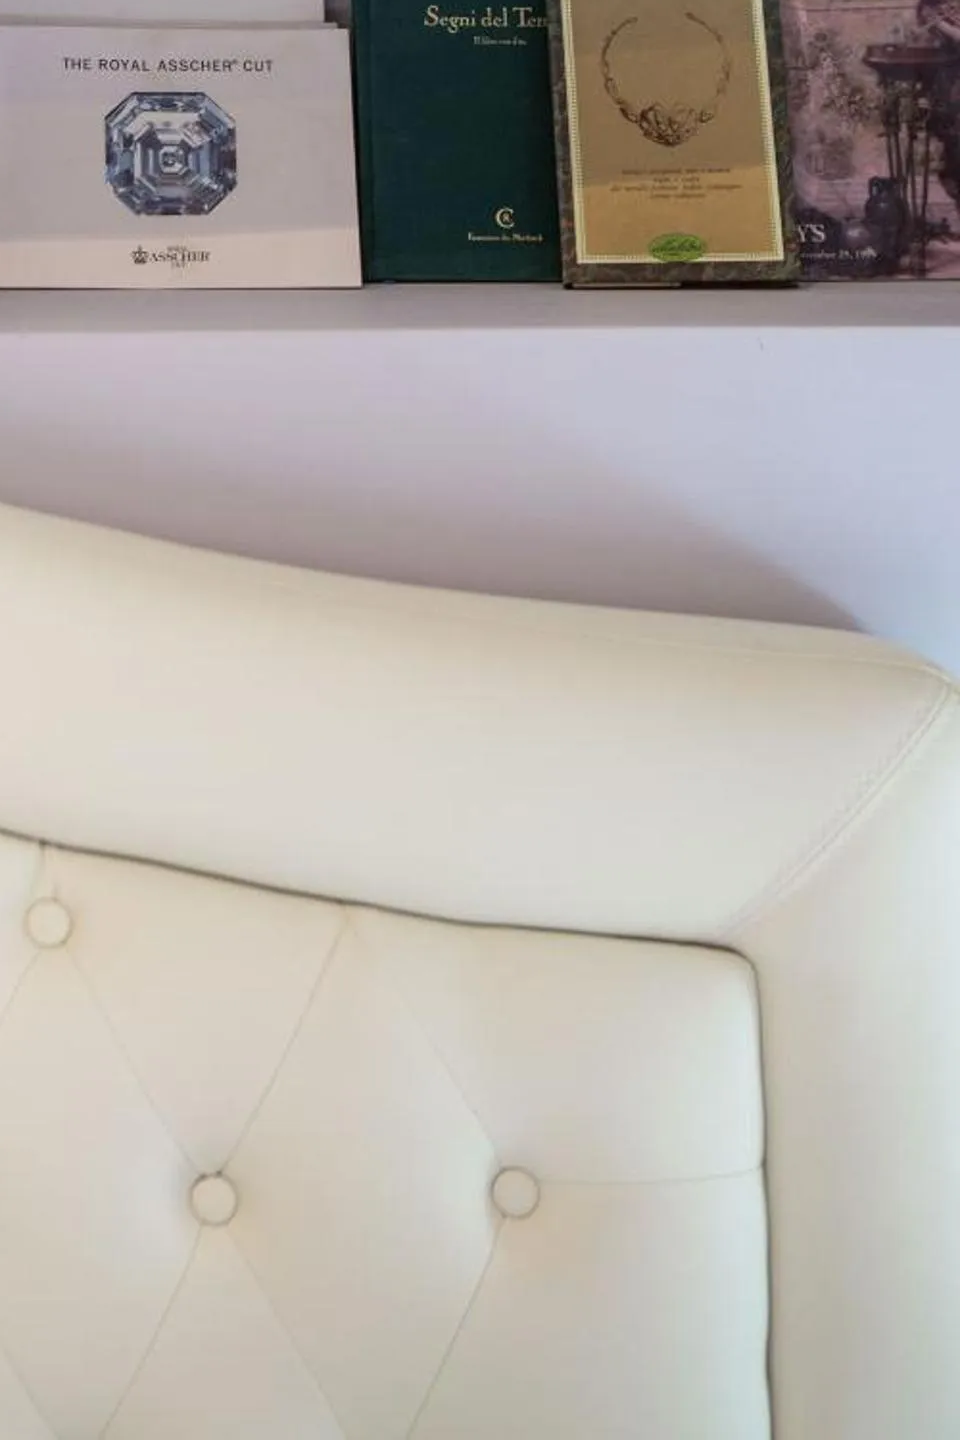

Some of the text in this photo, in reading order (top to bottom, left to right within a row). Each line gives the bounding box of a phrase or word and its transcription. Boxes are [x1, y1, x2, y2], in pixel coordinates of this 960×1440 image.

[424, 4, 477, 34] Segni
[481, 6, 508, 28] del
[64, 57, 91, 70] THE
[98, 59, 150, 72] ROYAL
[243, 59, 274, 72] CUT
